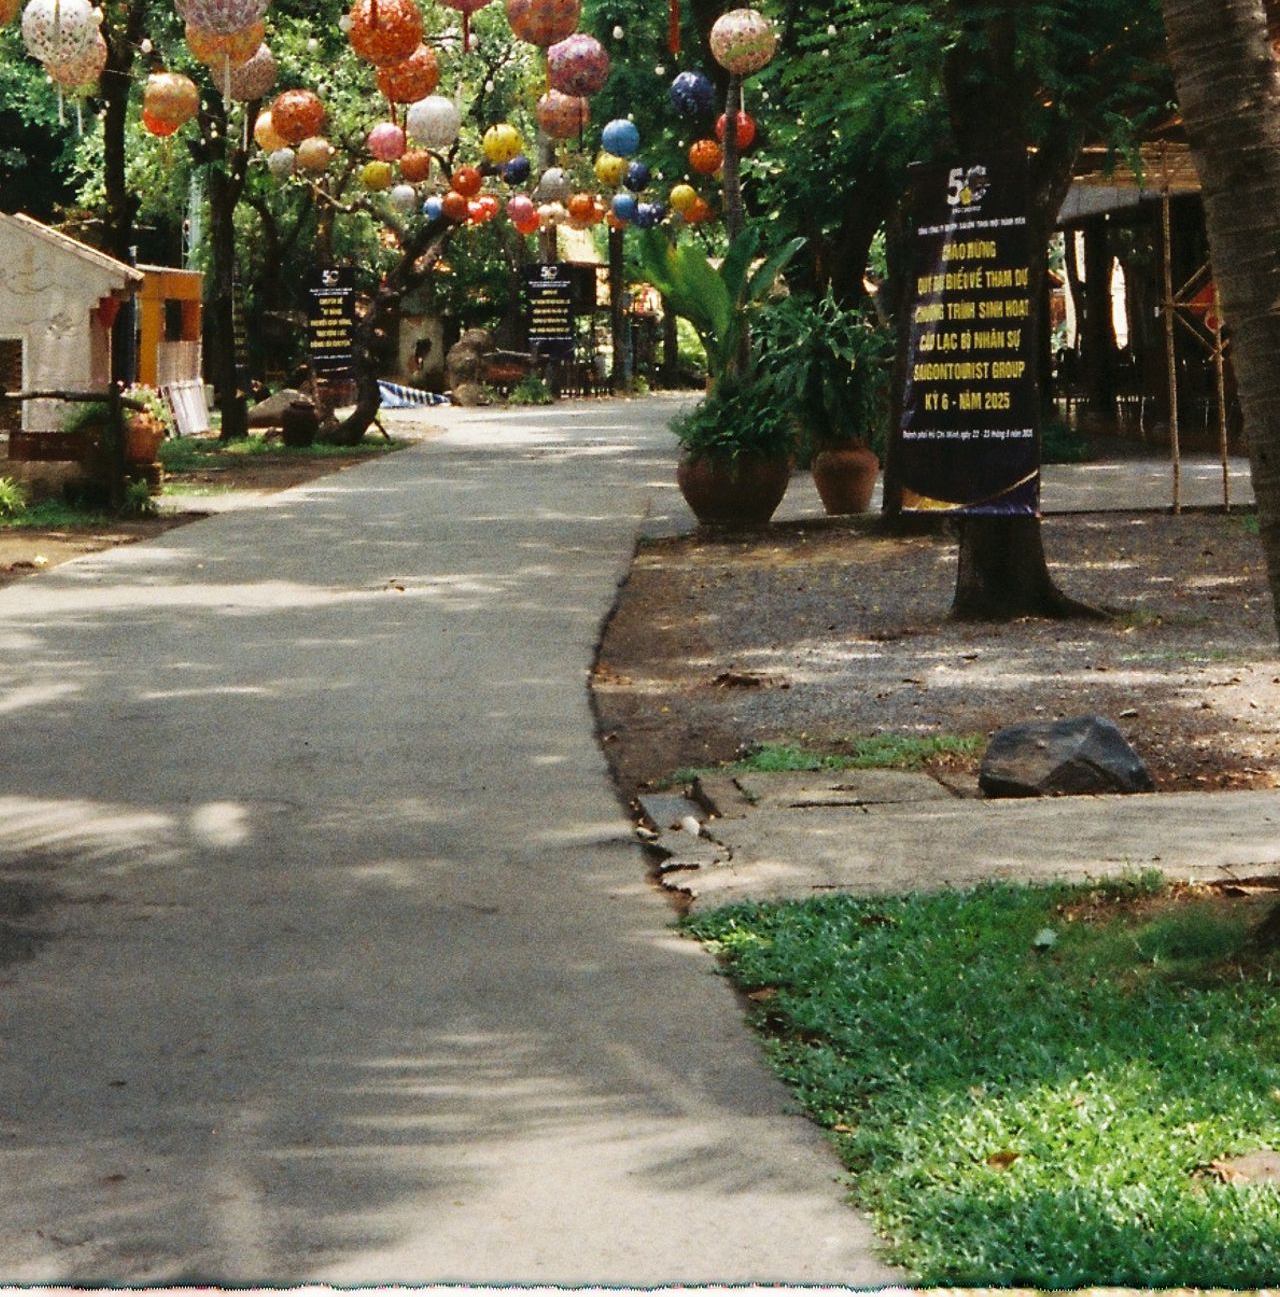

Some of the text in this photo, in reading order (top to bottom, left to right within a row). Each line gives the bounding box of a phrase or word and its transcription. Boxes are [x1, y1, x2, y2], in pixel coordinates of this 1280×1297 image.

[985, 269, 1013, 288] THAM
[978, 300, 1004, 319] SINH
[936, 333, 958, 354] LẠC
[973, 328, 1005, 349] NHÂN
[913, 361, 1025, 381] SAIGONTOURIST GROUP
[984, 392, 1011, 410] 2025
